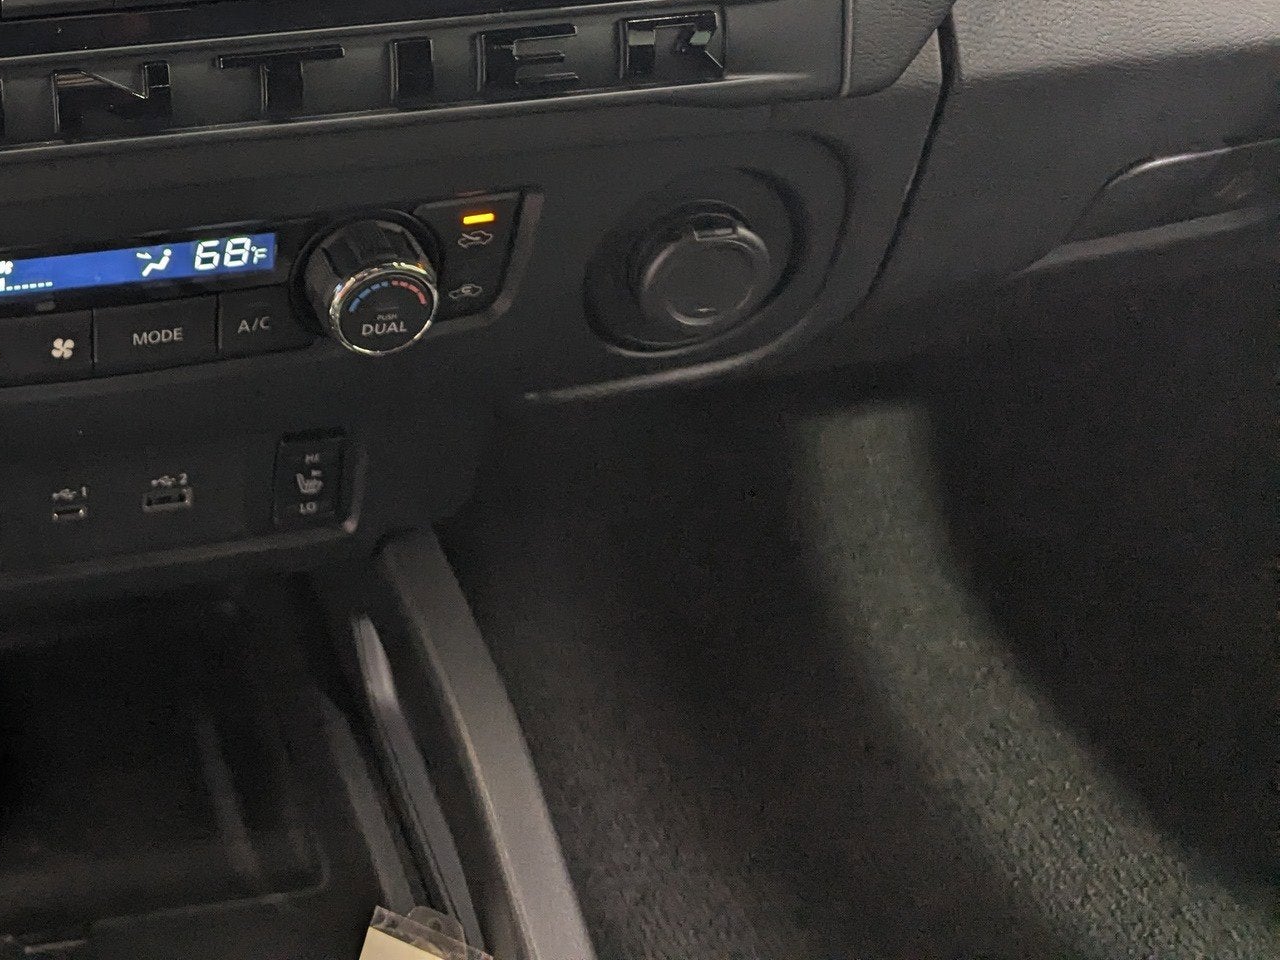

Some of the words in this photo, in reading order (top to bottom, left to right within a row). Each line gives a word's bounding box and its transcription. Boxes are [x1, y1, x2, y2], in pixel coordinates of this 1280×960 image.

[237, 315, 272, 334] A/C
[361, 321, 408, 337] DUAL
[132, 326, 185, 346] MODE
